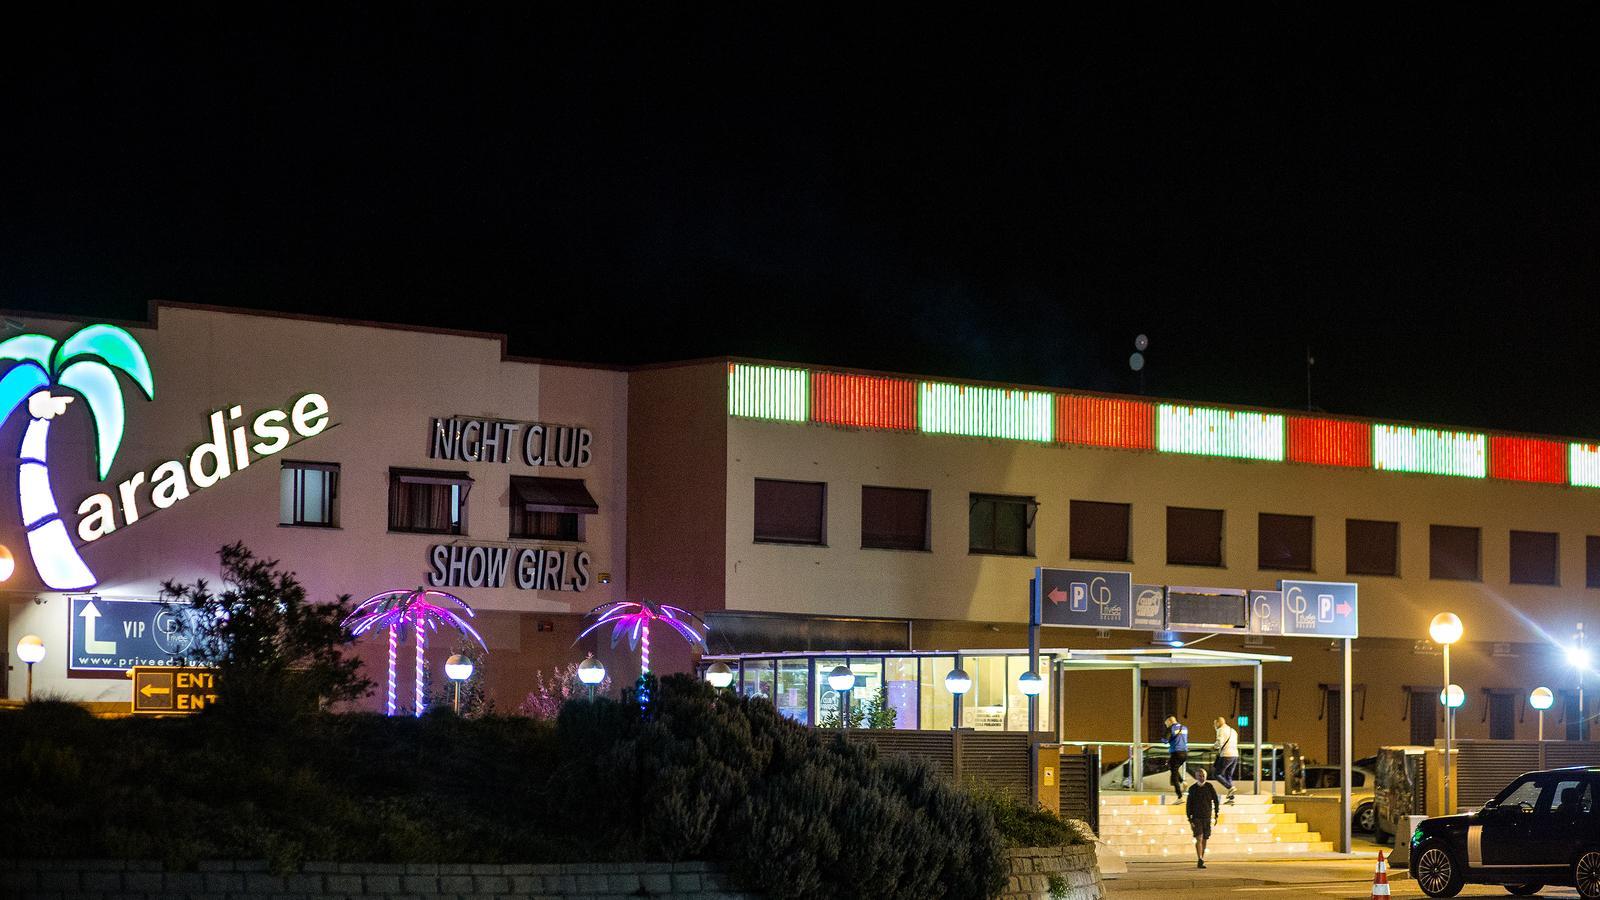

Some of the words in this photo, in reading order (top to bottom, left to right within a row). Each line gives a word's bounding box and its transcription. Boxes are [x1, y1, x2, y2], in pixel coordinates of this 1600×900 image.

[431, 418, 520, 463] NIGHT
[523, 423, 593, 467] CLUB
[429, 544, 511, 588] SHOW
[515, 549, 591, 592] GIRLS
[1073, 586, 1085, 608] P
[1320, 597, 1331, 619] P
[123, 620, 146, 639] VIP
